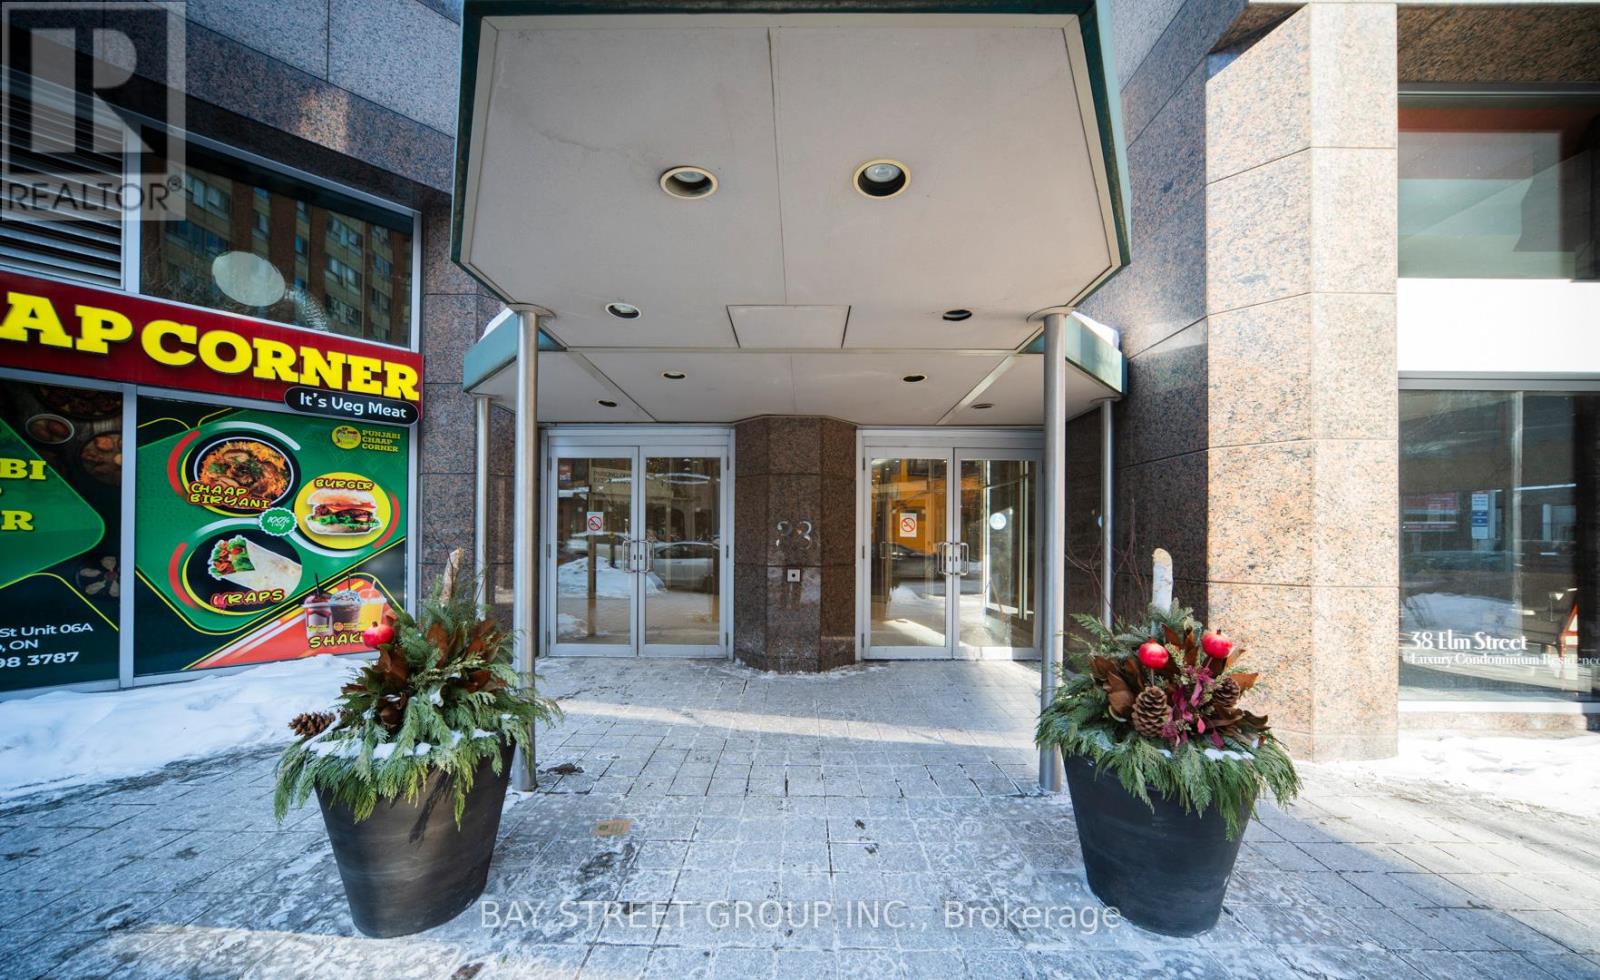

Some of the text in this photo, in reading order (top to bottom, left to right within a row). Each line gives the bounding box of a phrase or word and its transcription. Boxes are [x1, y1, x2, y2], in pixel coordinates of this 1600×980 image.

[141, 320, 420, 401] CORNER
[300, 391, 406, 418] It's Veg Meat
[362, 429, 400, 439] PUNJABI
[362, 443, 399, 452] CORNER
[191, 483, 247, 496] CHAAP
[315, 479, 373, 491] BURGER
[190, 493, 270, 509] BIRYANI
[21, 625, 57, 636] Unit
[60, 623, 93, 633] 06A
[9, 639, 39, 650] ON
[1410, 629, 1529, 650] 38 Elm Street
[27, 651, 79, 666] 3787
[1411, 653, 1453, 667] Luxury
[1455, 653, 1540, 666] Condominium
